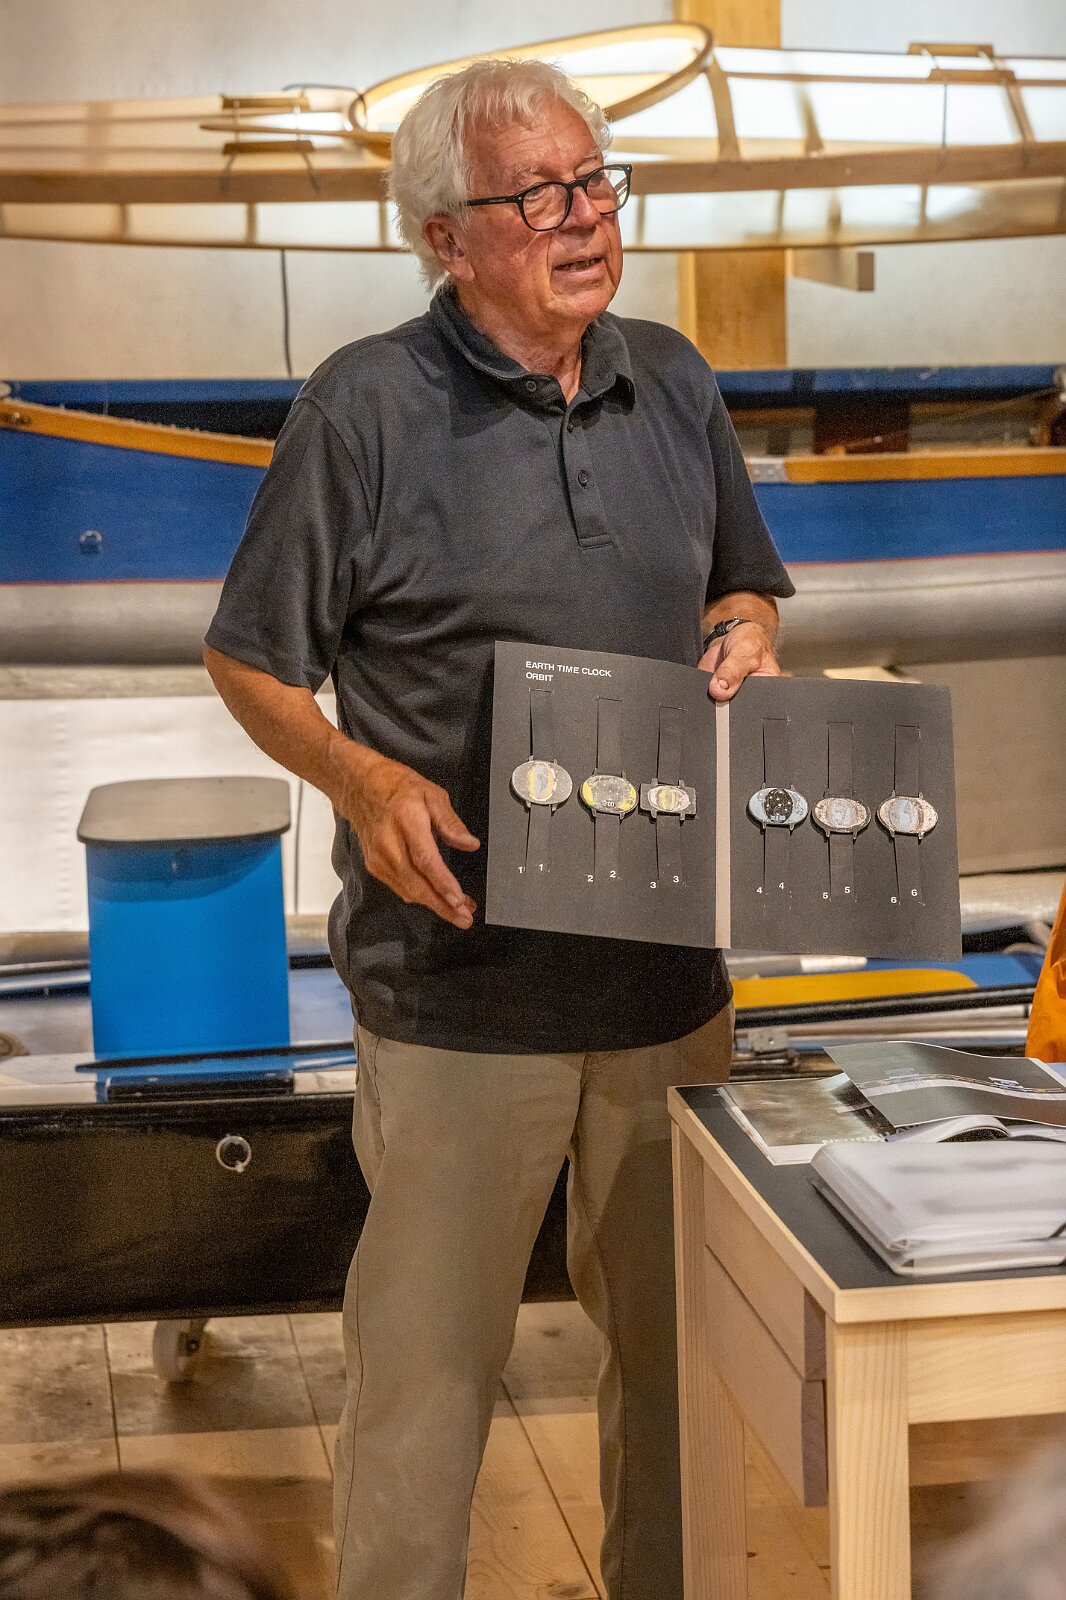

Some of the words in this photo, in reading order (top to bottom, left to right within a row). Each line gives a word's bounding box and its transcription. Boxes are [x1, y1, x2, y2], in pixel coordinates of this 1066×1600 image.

[525, 660, 554, 671] EARTH
[556, 664, 580, 673] TIME
[581, 667, 611, 677] CLOCK
[525, 671, 553, 681] ORBIT
[538, 863, 544, 872] 1
[587, 874, 594, 883] 2
[609, 870, 617, 878] 2
[650, 881, 657, 889] 3
[672, 875, 680, 883] 3
[756, 886, 763, 894] 4
[778, 881, 785, 890] 4
[844, 886, 851, 894] 5
[890, 896, 897, 904] 6
[911, 888, 918, 897] 6
